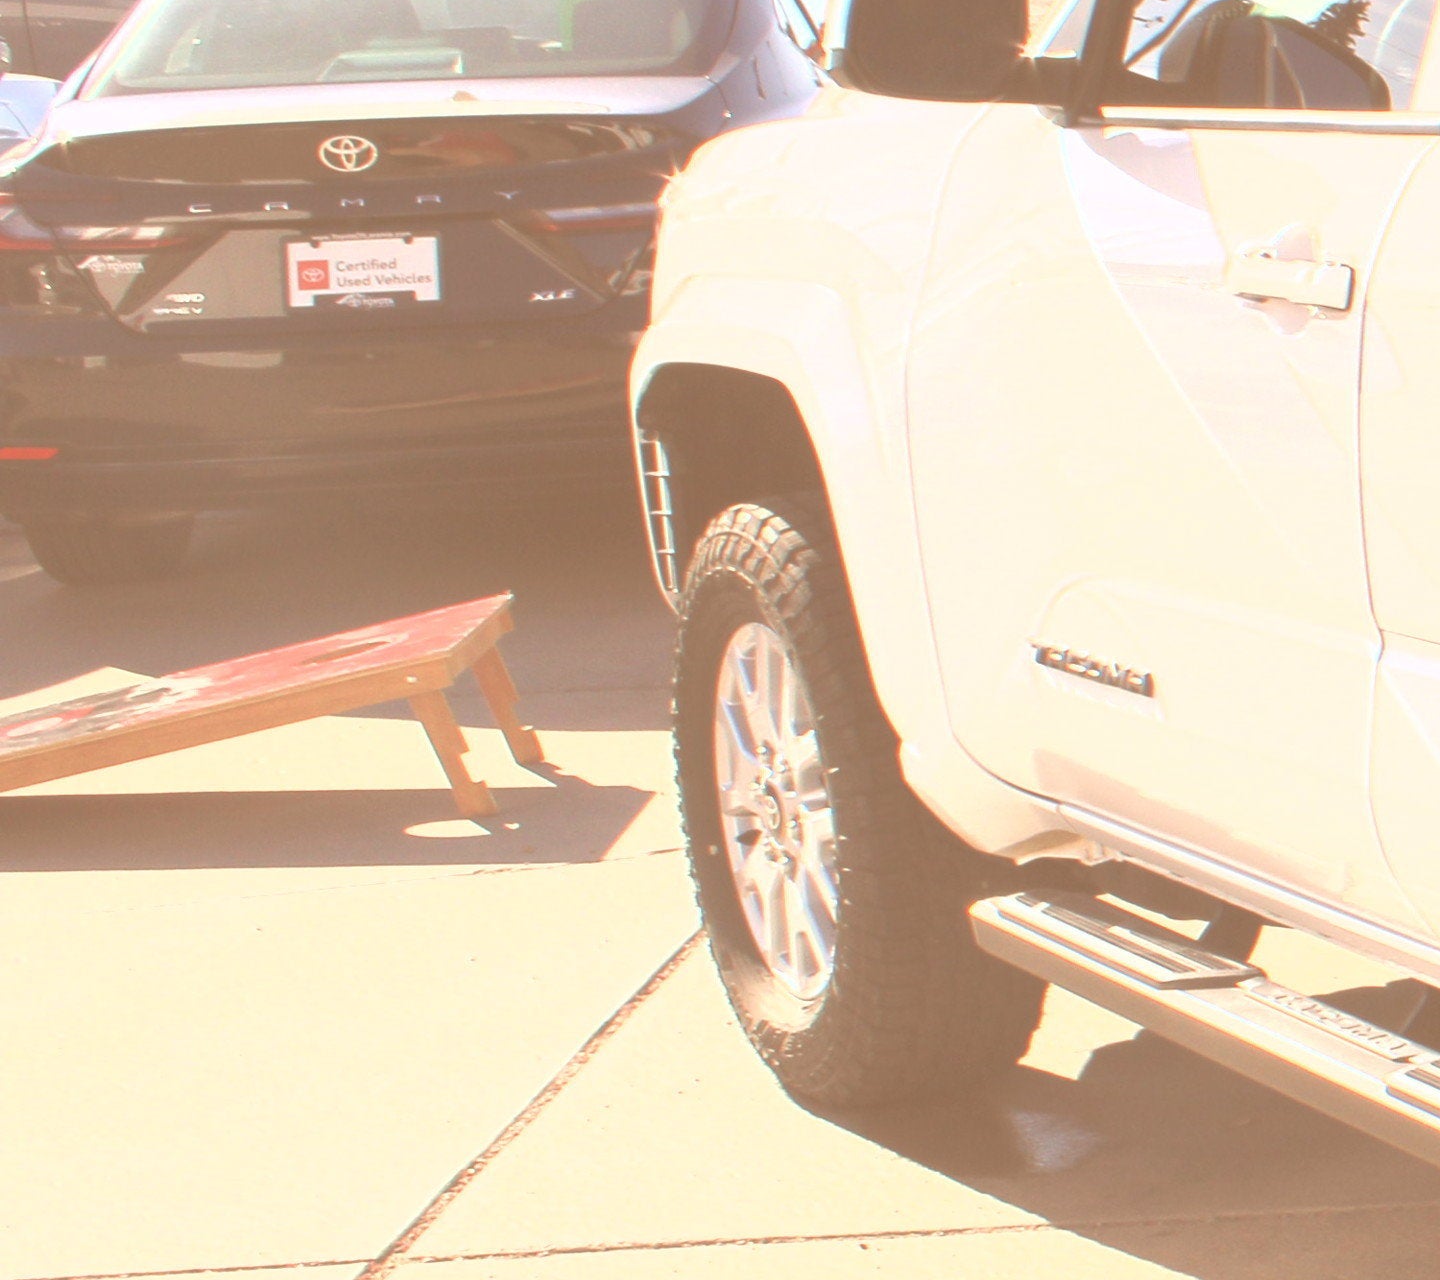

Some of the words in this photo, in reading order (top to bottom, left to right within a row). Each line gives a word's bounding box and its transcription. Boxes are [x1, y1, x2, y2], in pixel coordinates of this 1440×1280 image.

[336, 258, 398, 272] Certified
[336, 276, 372, 288] Used
[375, 272, 432, 286] Vehicles
